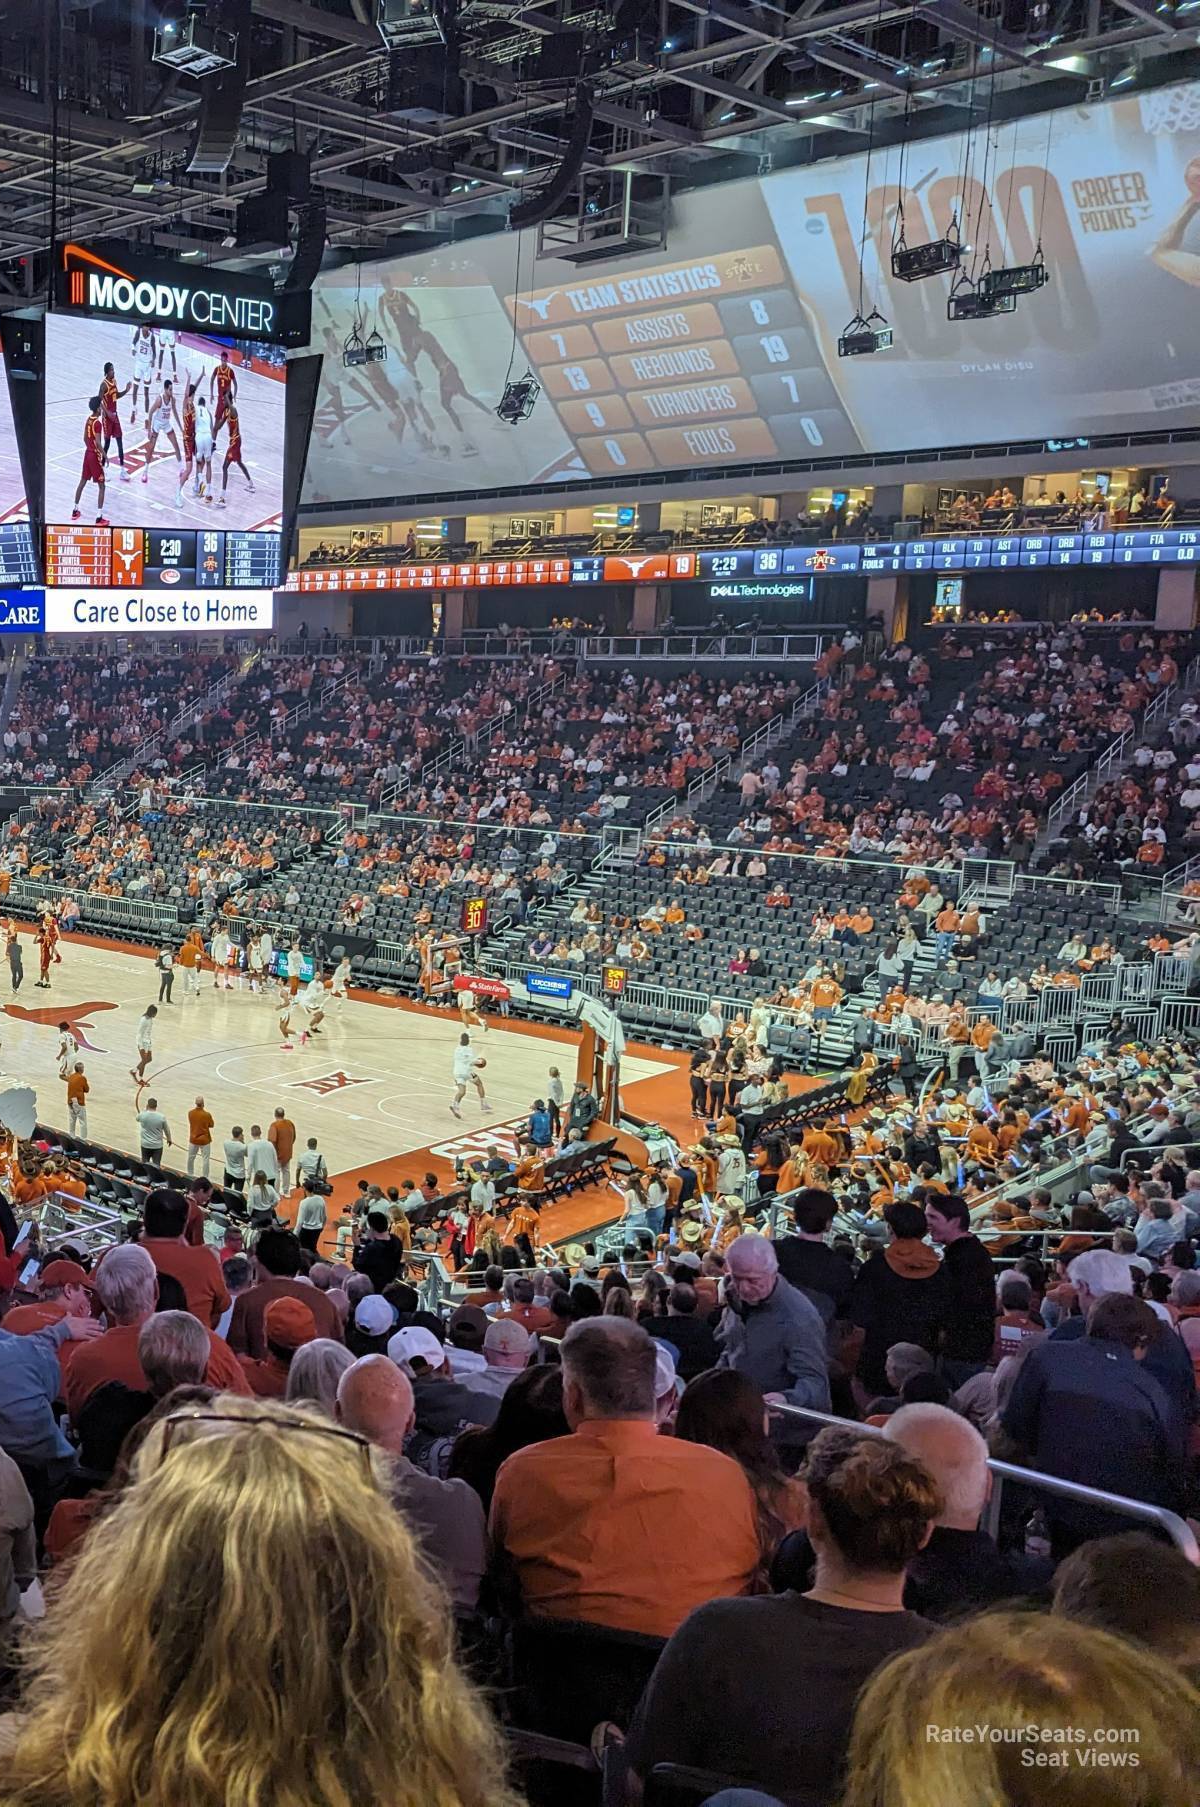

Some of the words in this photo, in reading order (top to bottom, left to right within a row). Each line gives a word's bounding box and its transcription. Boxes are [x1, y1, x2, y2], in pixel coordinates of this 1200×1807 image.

[1071, 171, 1149, 209] CAREER
[1079, 205, 1137, 234] POINTS
[566, 282, 620, 313] TEAM
[620, 264, 721, 303] STATISTICS
[89, 273, 190, 319] MOODY
[190, 290, 273, 332] CENTER
[749, 299, 770, 325] 8
[550, 333, 568, 358] 7
[625, 312, 690, 344] ASSISTS
[760, 335, 790, 363] 19
[563, 366, 591, 391] 13
[631, 349, 716, 381] REBOUNDS
[961, 362, 1001, 374] DYLAN
[780, 375, 800, 403] 7
[584, 402, 606, 428] 9
[643, 385, 737, 418] TURNOVERS
[800, 417, 824, 447] 0
[604, 439, 626, 466] 0
[683, 426, 736, 456] FOULS
[121, 528, 134, 551] 19
[160, 539, 181, 557] 2:30
[203, 531, 218, 553] 36
[913, 544, 926, 554] STL
[942, 543, 956, 553] BLK
[973, 542, 982, 551] TO
[997, 540, 1012, 551] AST
[1058, 538, 1074, 548] DRB
[1090, 537, 1105, 547] REB
[1124, 535, 1135, 546] FT
[1150, 535, 1164, 545] FTA
[864, 547, 877, 557] TOL
[893, 545, 900, 555] 4
[916, 558, 922, 568] 5
[945, 557, 951, 567] 2
[974, 556, 980, 566] 7
[1000, 555, 1007, 565] 8
[1029, 554, 1036, 565] 5
[1060, 553, 1070, 564] 14
[1092, 551, 1102, 563] 19
[1124, 550, 1132, 561] 0
[1152, 550, 1160, 560] 0
[1177, 548, 1193, 560] 0.0
[593, 559, 599, 569] 2
[675, 557, 689, 573] 19
[711, 557, 737, 572] 2:29
[759, 552, 777, 570] 36
[805, 556, 837, 567] STATE
[862, 559, 884, 570] FOULS
[893, 559, 899, 569] 0
[499, 575, 504, 583] 7
[572, 572, 589, 581] FOULS
[592, 571, 598, 580] 0
[711, 585, 740, 597] DELL
[738, 583, 805, 598] Technologies
[74, 598, 119, 623] Care
[125, 598, 177, 623] Close
[182, 601, 200, 622] to
[206, 599, 258, 623] Home
[466, 911, 481, 928] 30
[531, 978, 568, 990] LUCCHESE
[607, 978, 619, 989] 30
